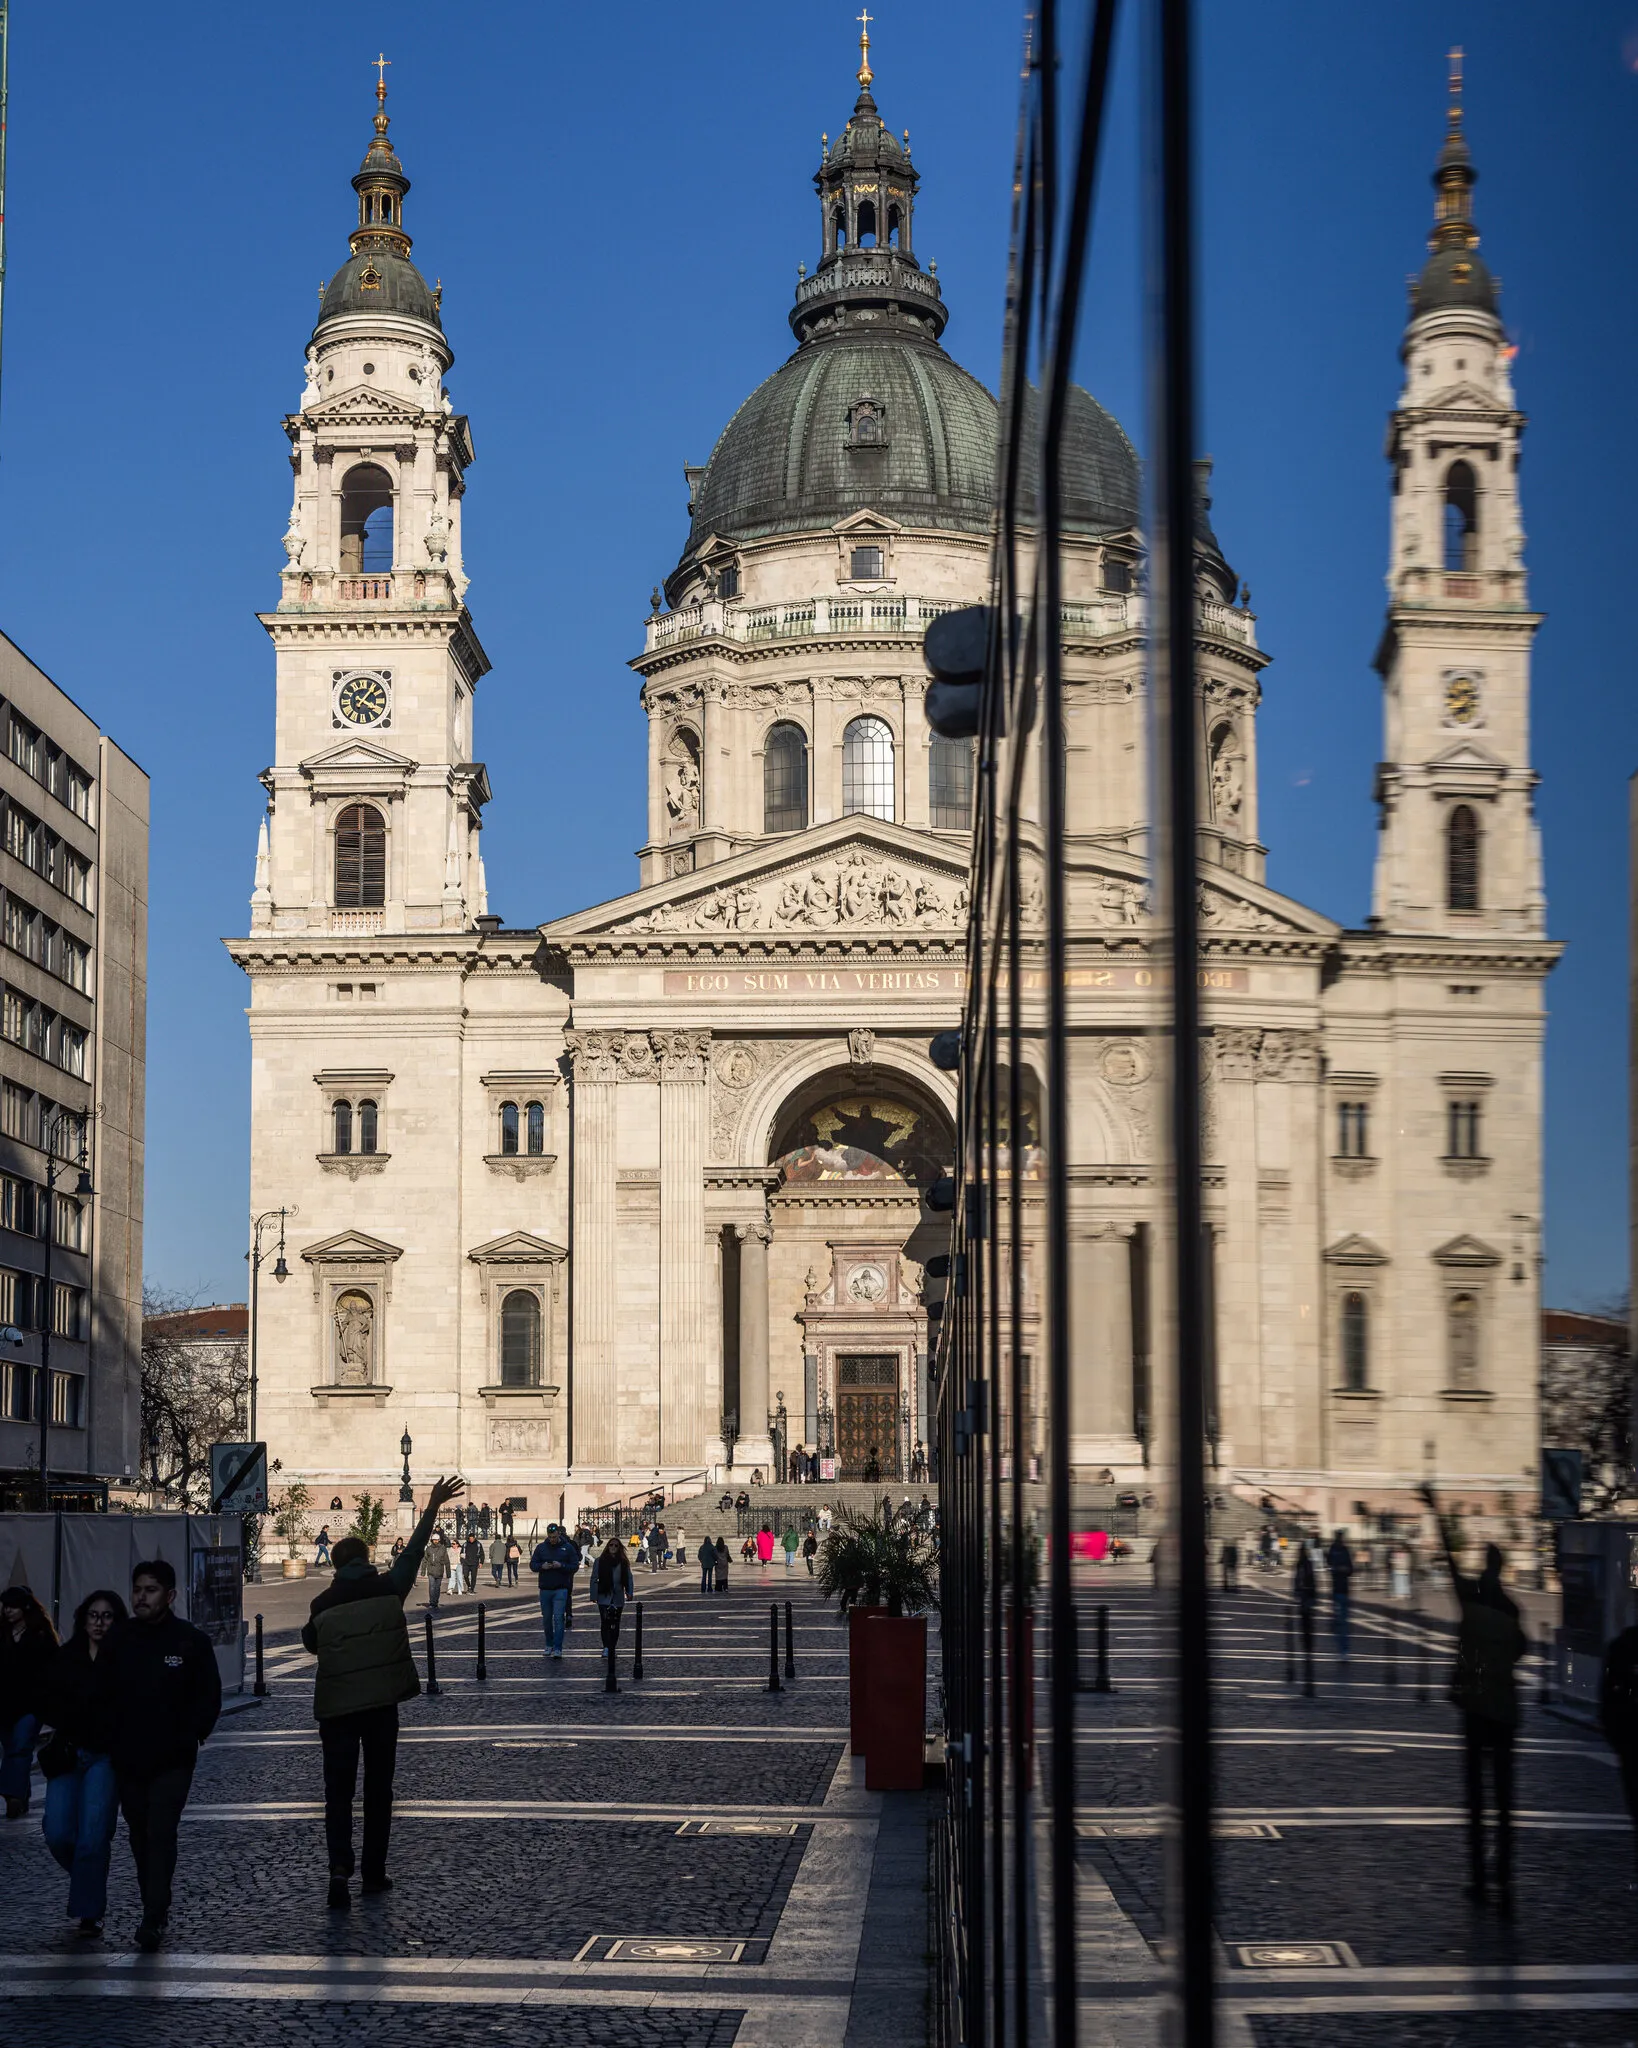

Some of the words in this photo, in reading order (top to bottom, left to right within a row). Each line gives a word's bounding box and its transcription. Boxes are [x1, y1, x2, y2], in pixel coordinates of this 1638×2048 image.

[687, 974, 729, 991] EGO
[744, 974, 789, 990] SUM
[806, 973, 841, 990] VIA
[854, 972, 939, 990] VERITAS
